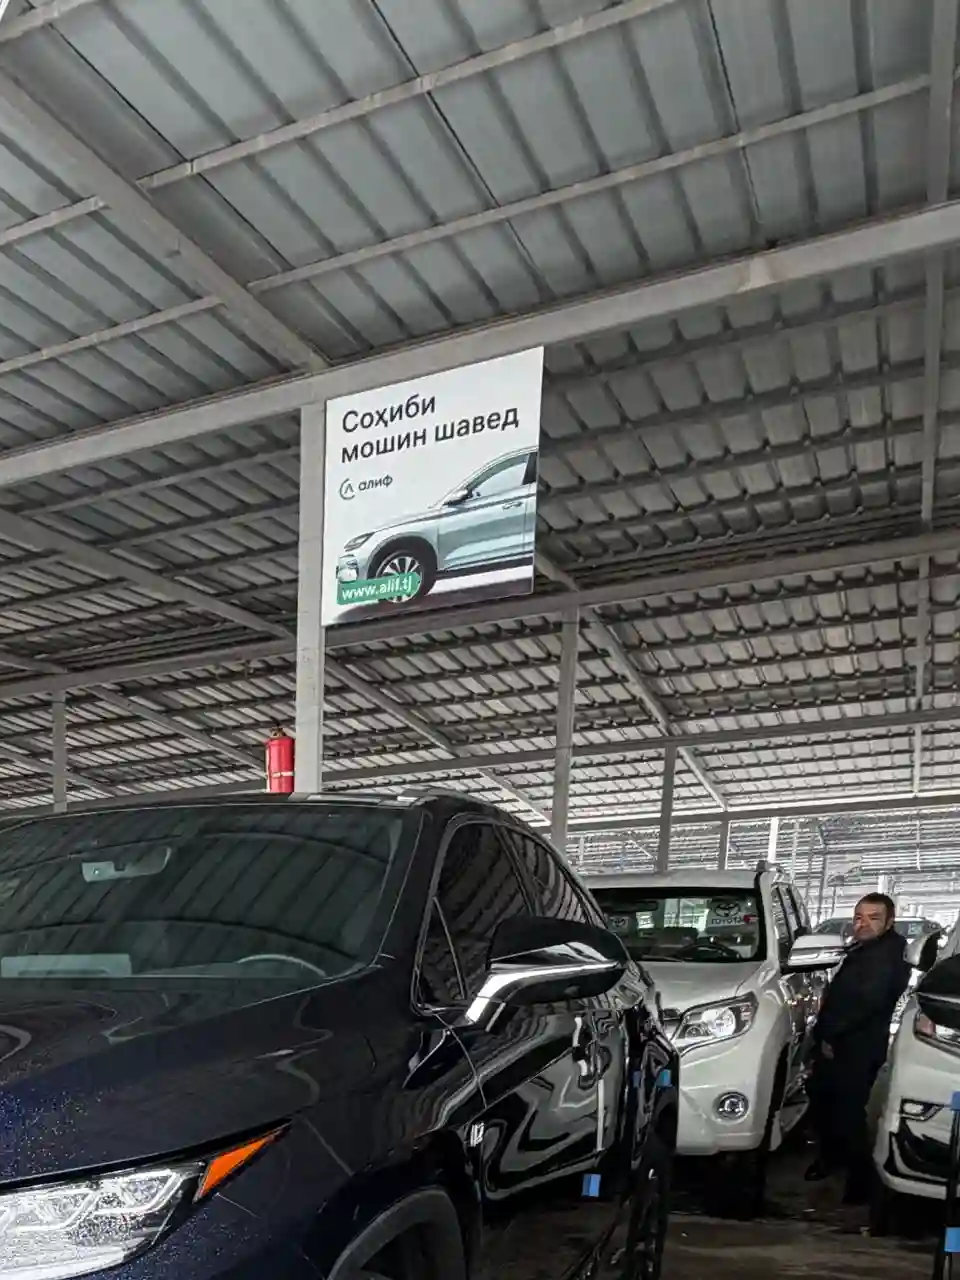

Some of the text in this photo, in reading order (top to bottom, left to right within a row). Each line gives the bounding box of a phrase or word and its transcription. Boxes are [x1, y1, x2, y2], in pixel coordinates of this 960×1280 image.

[342, 393, 436, 434] Соҳиби
[341, 407, 520, 464] мошин шавед
[358, 474, 394, 491] алиф
